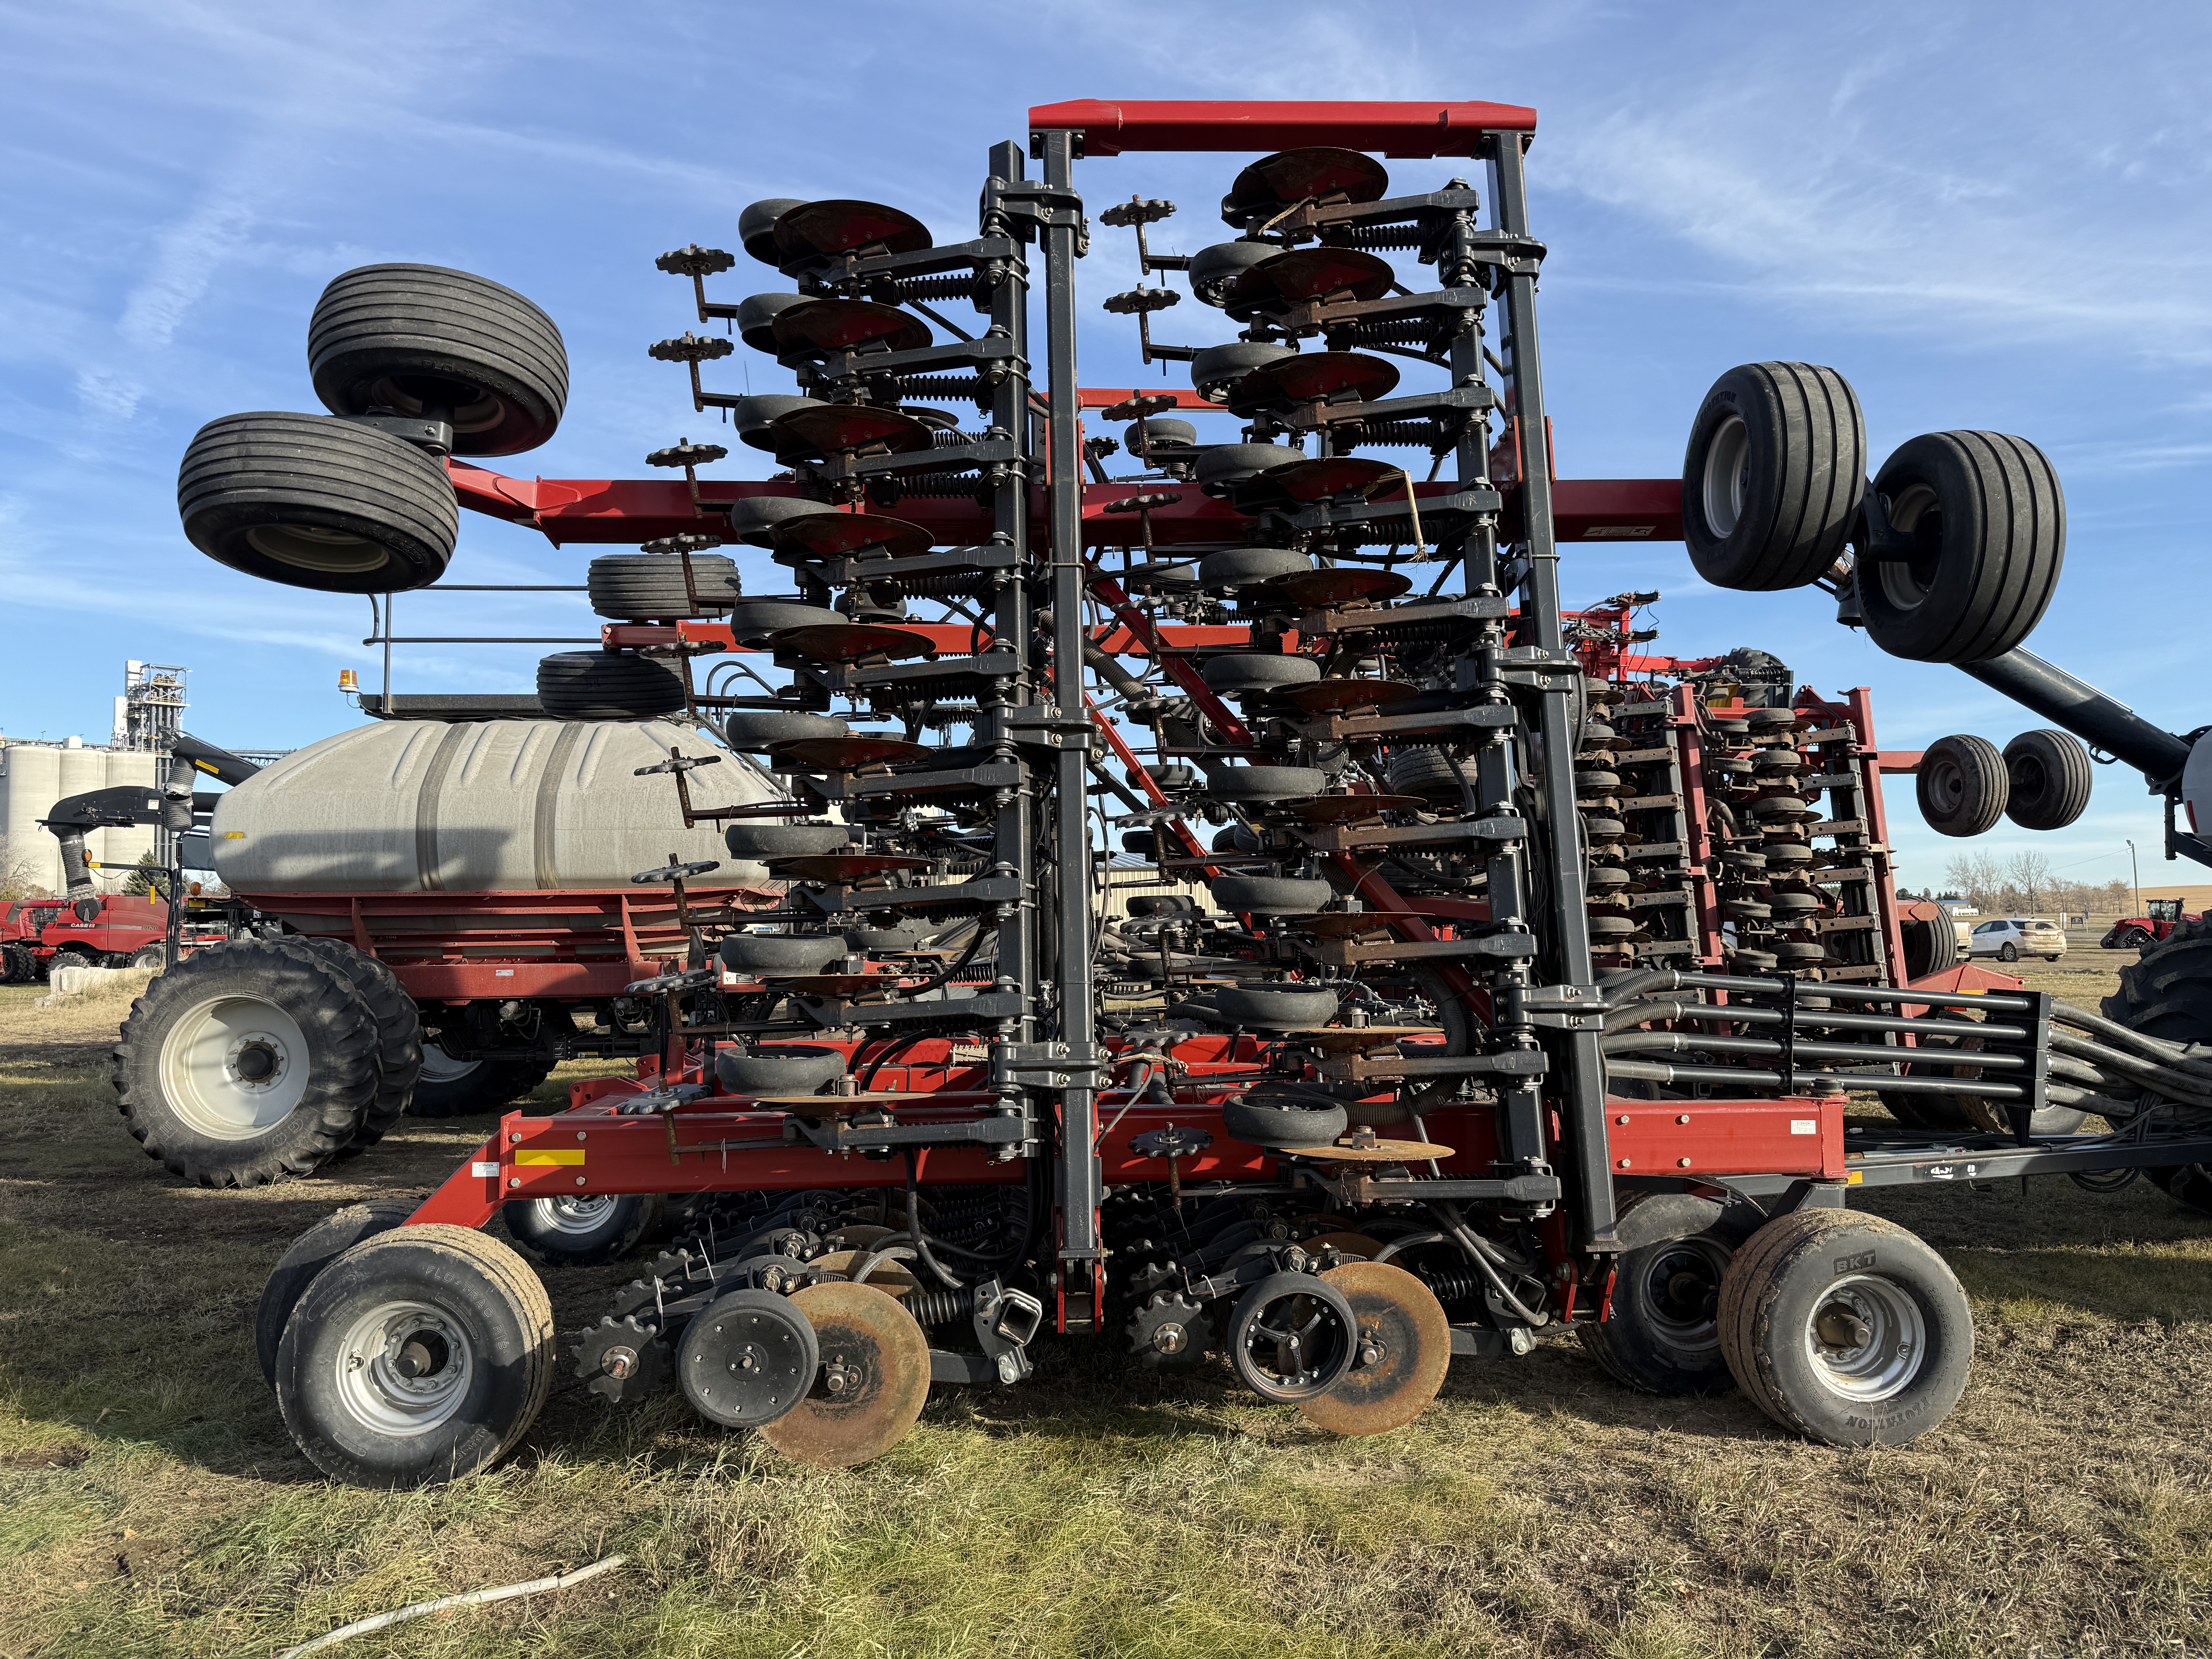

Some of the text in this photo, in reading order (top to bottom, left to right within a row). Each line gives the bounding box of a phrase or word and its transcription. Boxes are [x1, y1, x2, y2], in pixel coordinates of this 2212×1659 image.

[508, 389, 529, 405] RIB
[1639, 1212, 1660, 1230] RIB
[1835, 1251, 1875, 1274] BKT
[425, 1265, 494, 1317] FLO-TRAC
[492, 1324, 508, 1350] RIB
[1845, 1396, 1930, 1430] FLOTATION
[311, 1437, 359, 1475] TITAN
